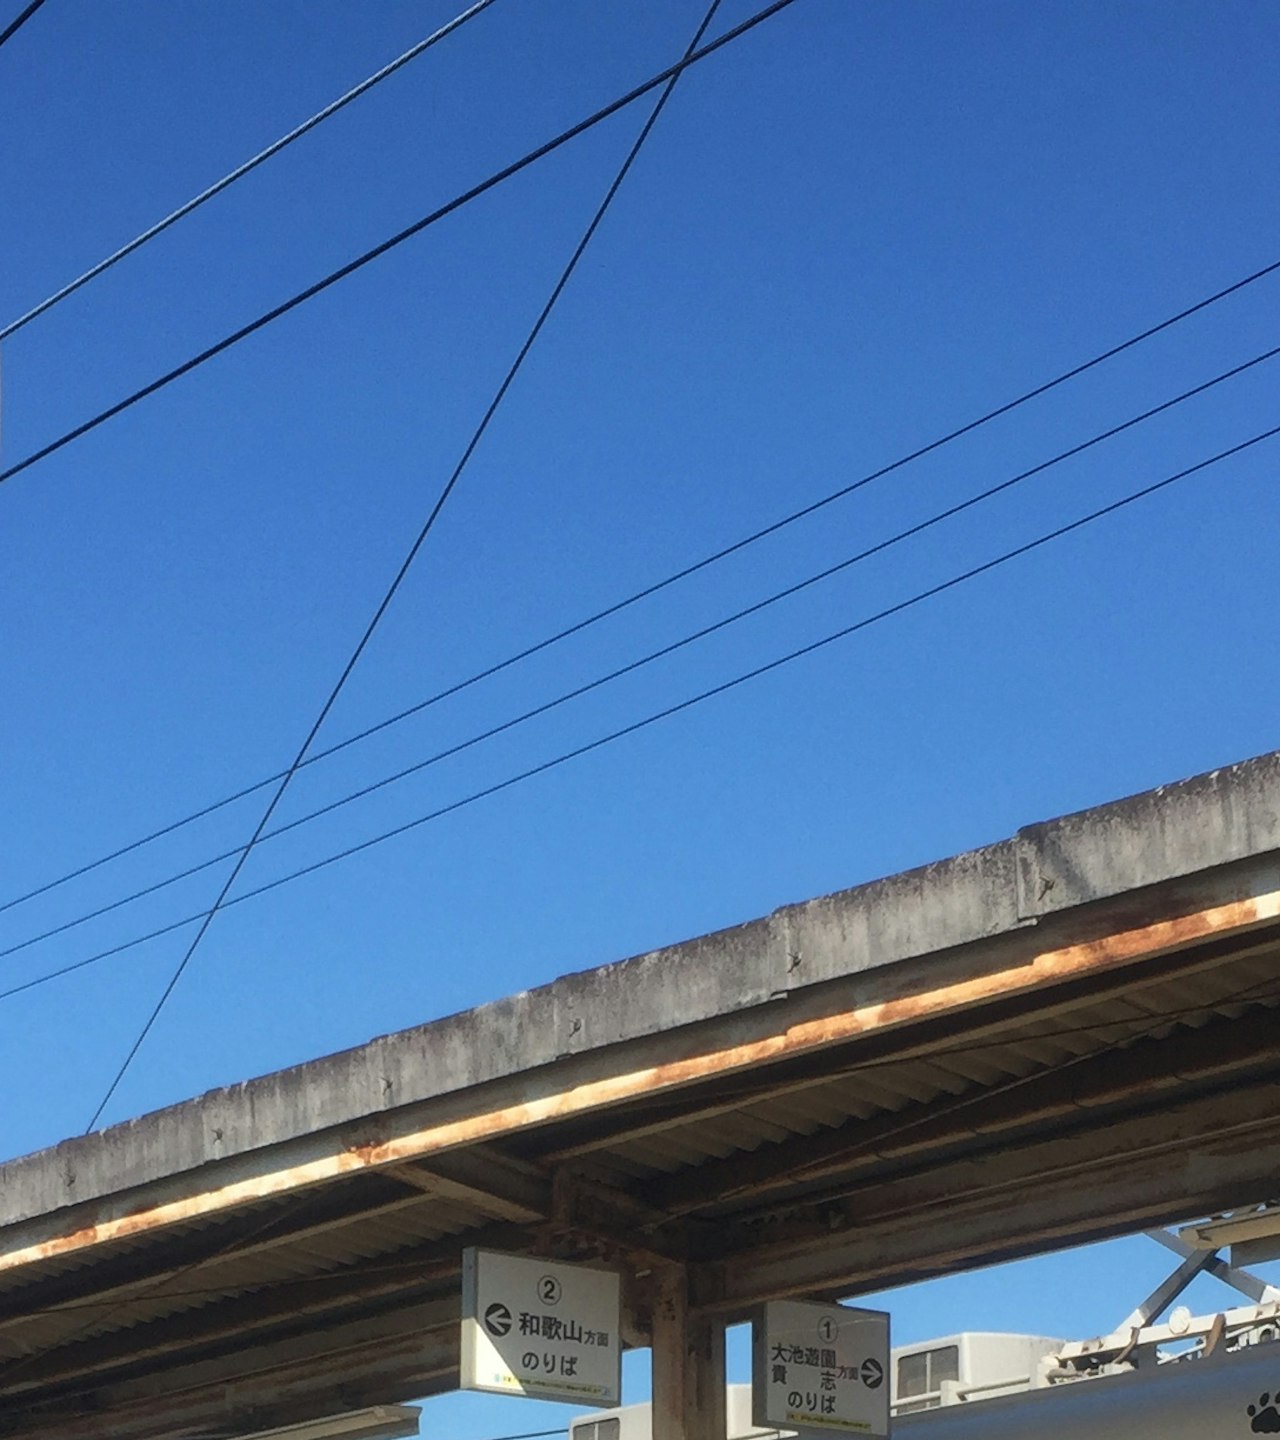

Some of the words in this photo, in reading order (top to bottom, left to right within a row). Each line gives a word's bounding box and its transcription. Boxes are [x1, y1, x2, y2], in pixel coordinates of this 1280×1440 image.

[543, 1279, 556, 1300] 2
[519, 1312, 609, 1347] 和歌山方面
[522, 1352, 578, 1376] のりば
[771, 1342, 836, 1369] 大池遊園
[787, 1391, 836, 1414] のりば
